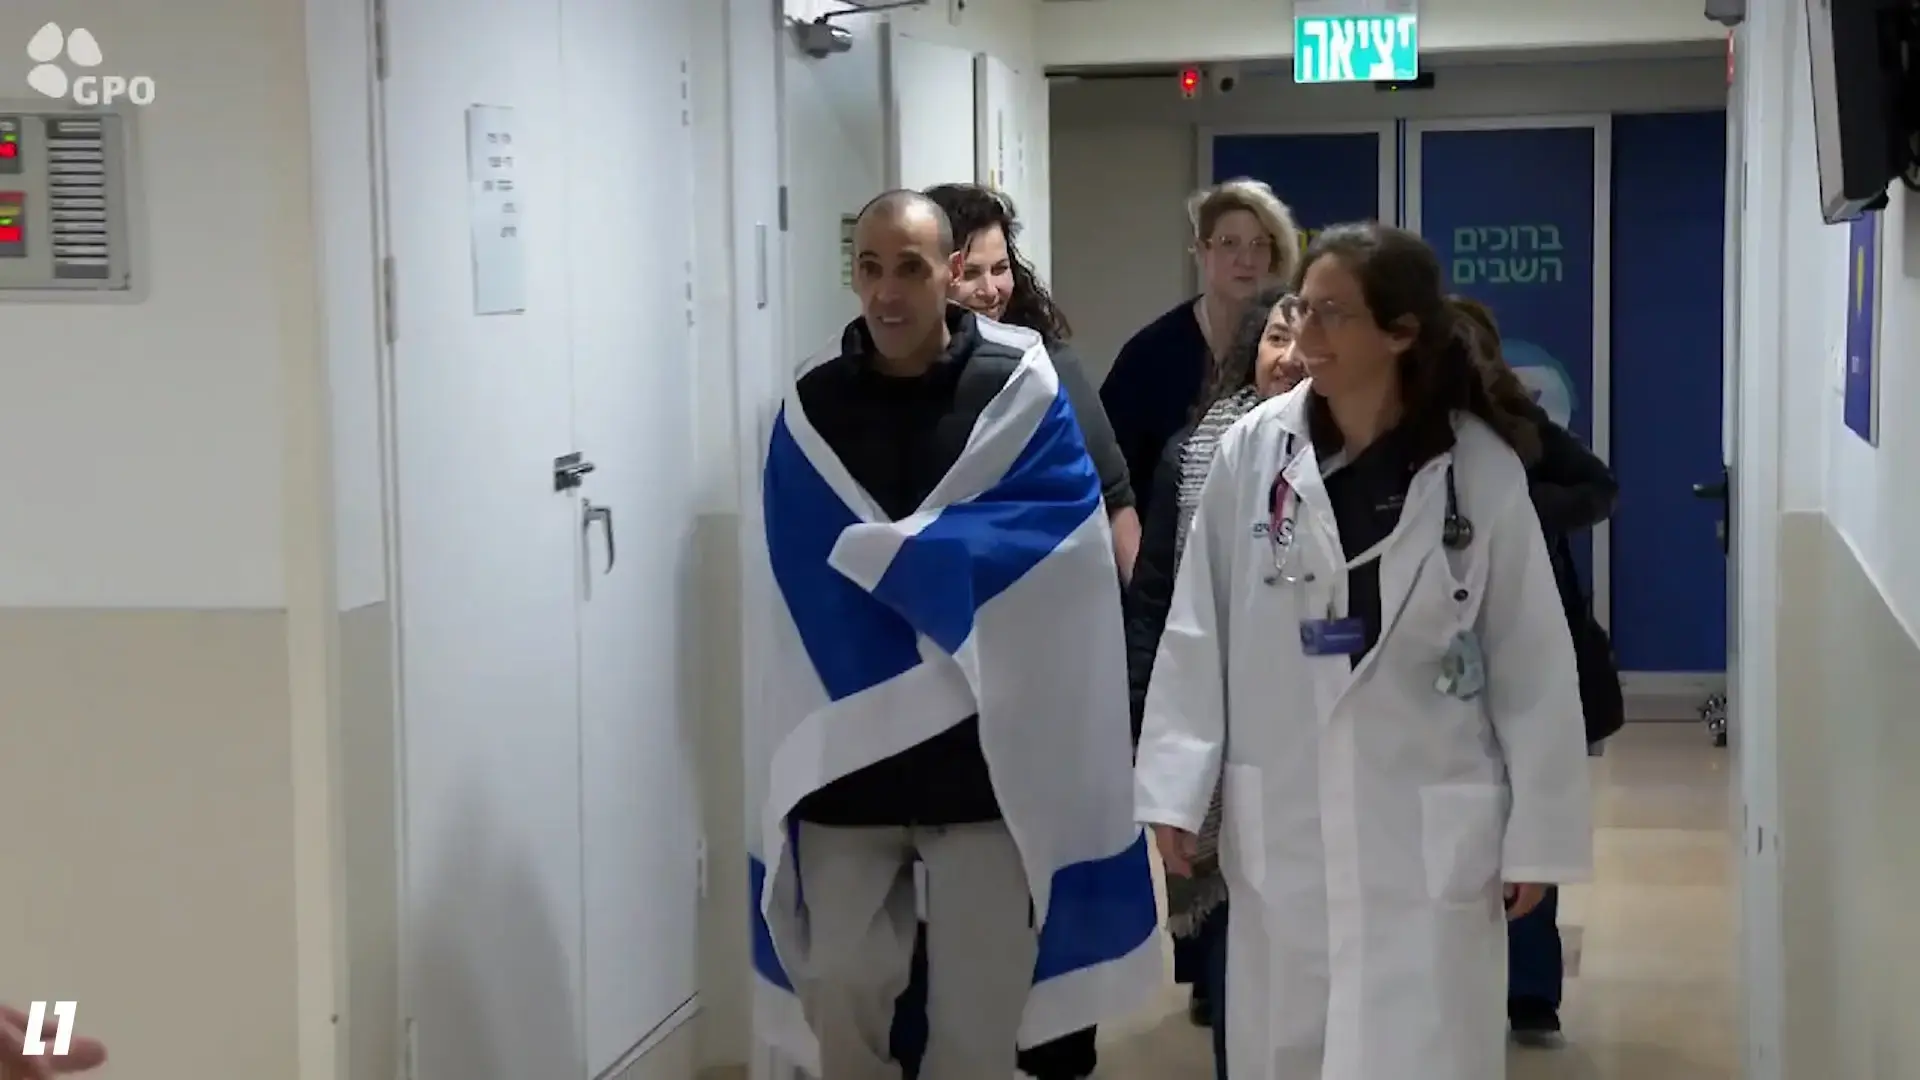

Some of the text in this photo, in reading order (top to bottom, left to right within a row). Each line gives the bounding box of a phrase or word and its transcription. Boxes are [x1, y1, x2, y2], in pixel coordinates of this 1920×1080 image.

[1303, 17, 1415, 80] יציאה
[1453, 225, 1563, 252] ברוכים
[1453, 257, 1562, 283] השבים
